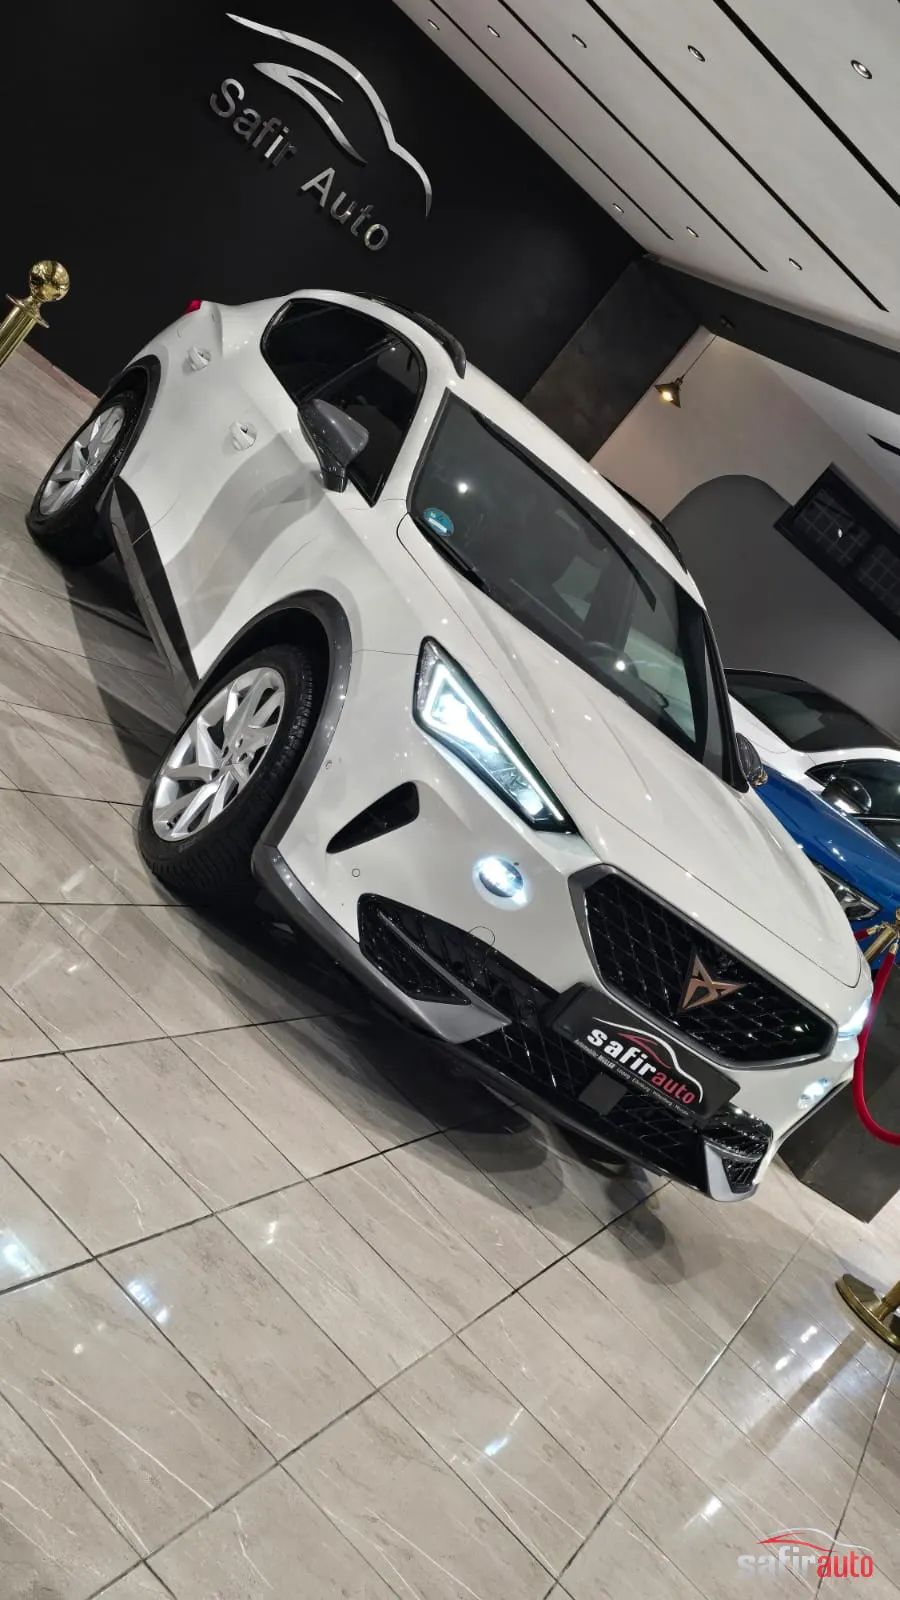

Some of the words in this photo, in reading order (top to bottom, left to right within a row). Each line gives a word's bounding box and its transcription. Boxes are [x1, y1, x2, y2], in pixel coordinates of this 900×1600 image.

[209, 78, 297, 167] Safir
[300, 167, 389, 250] Auto
[587, 1029, 696, 1105] safirauto
